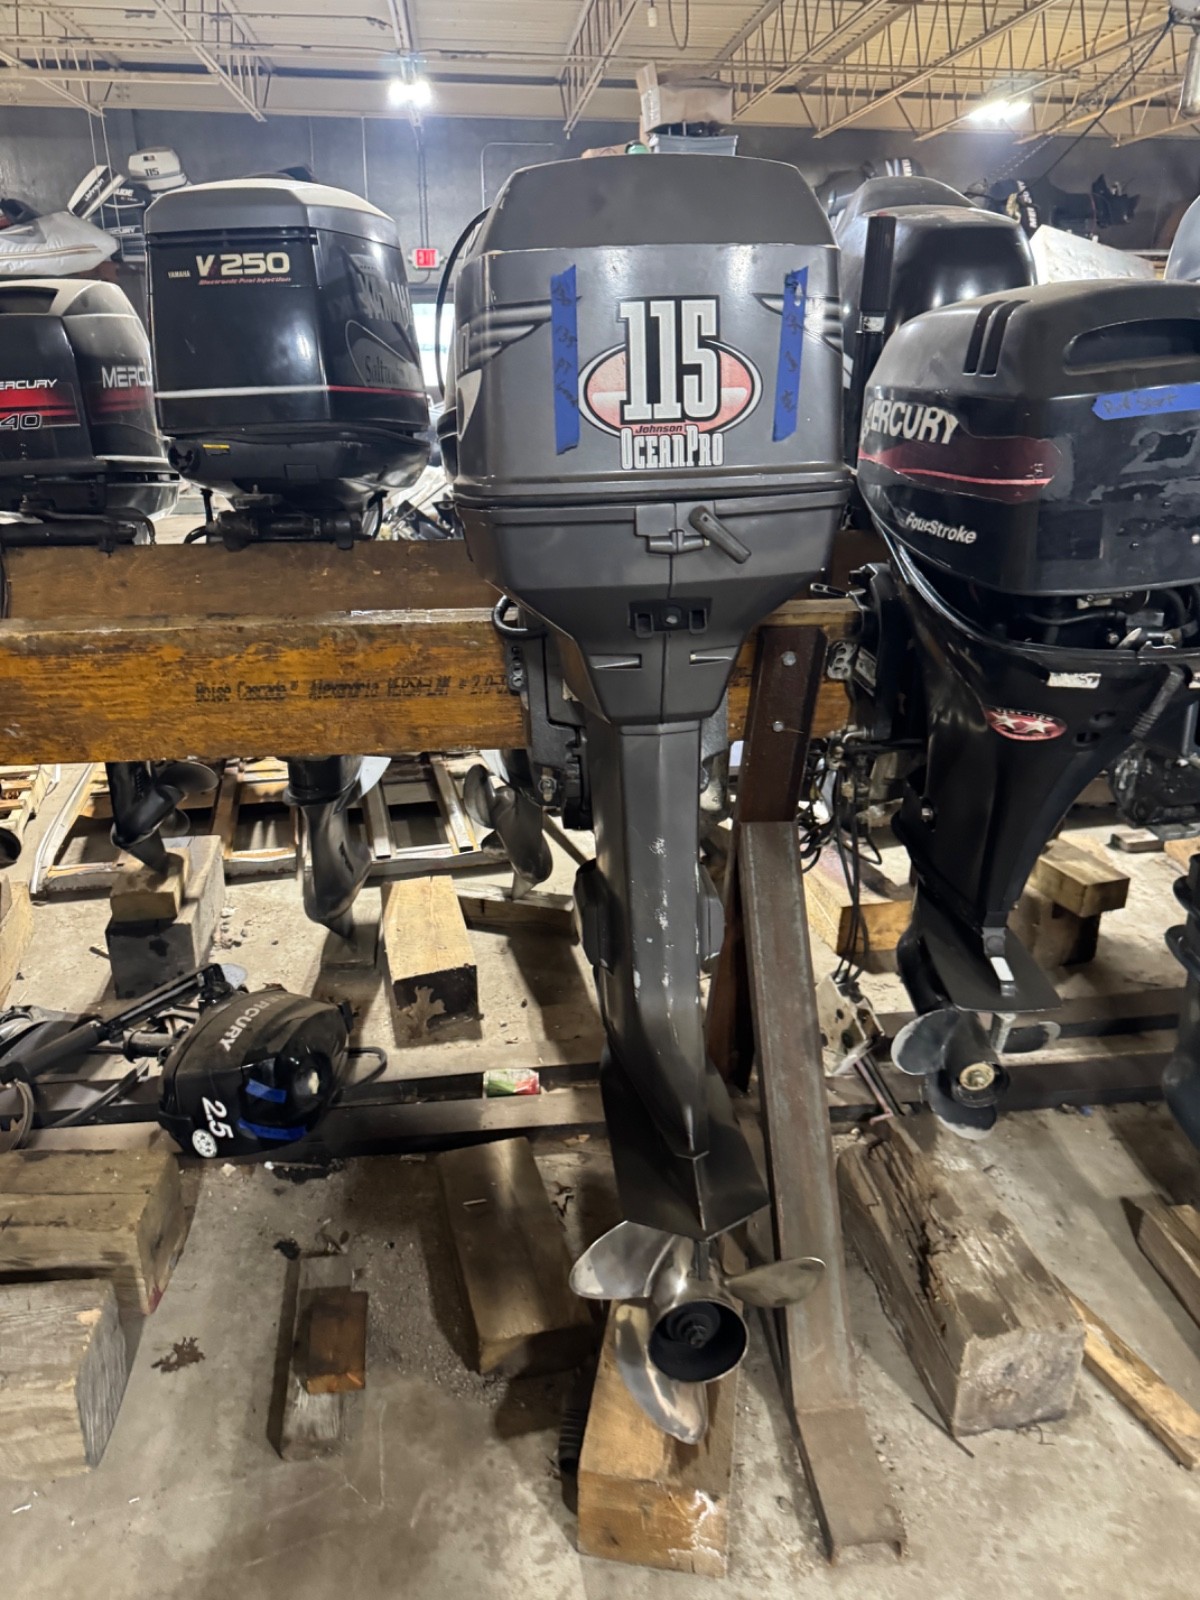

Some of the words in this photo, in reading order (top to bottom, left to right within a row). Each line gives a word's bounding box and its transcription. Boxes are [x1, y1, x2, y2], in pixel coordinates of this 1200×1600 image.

[145, 168, 160, 176] 115
[416, 249, 436, 266] EXIT
[168, 270, 191, 278] YAMAHA
[617, 295, 721, 424] 115
[635, 424, 683, 434] Johnson
[202, 1096, 235, 1139] 2.5
